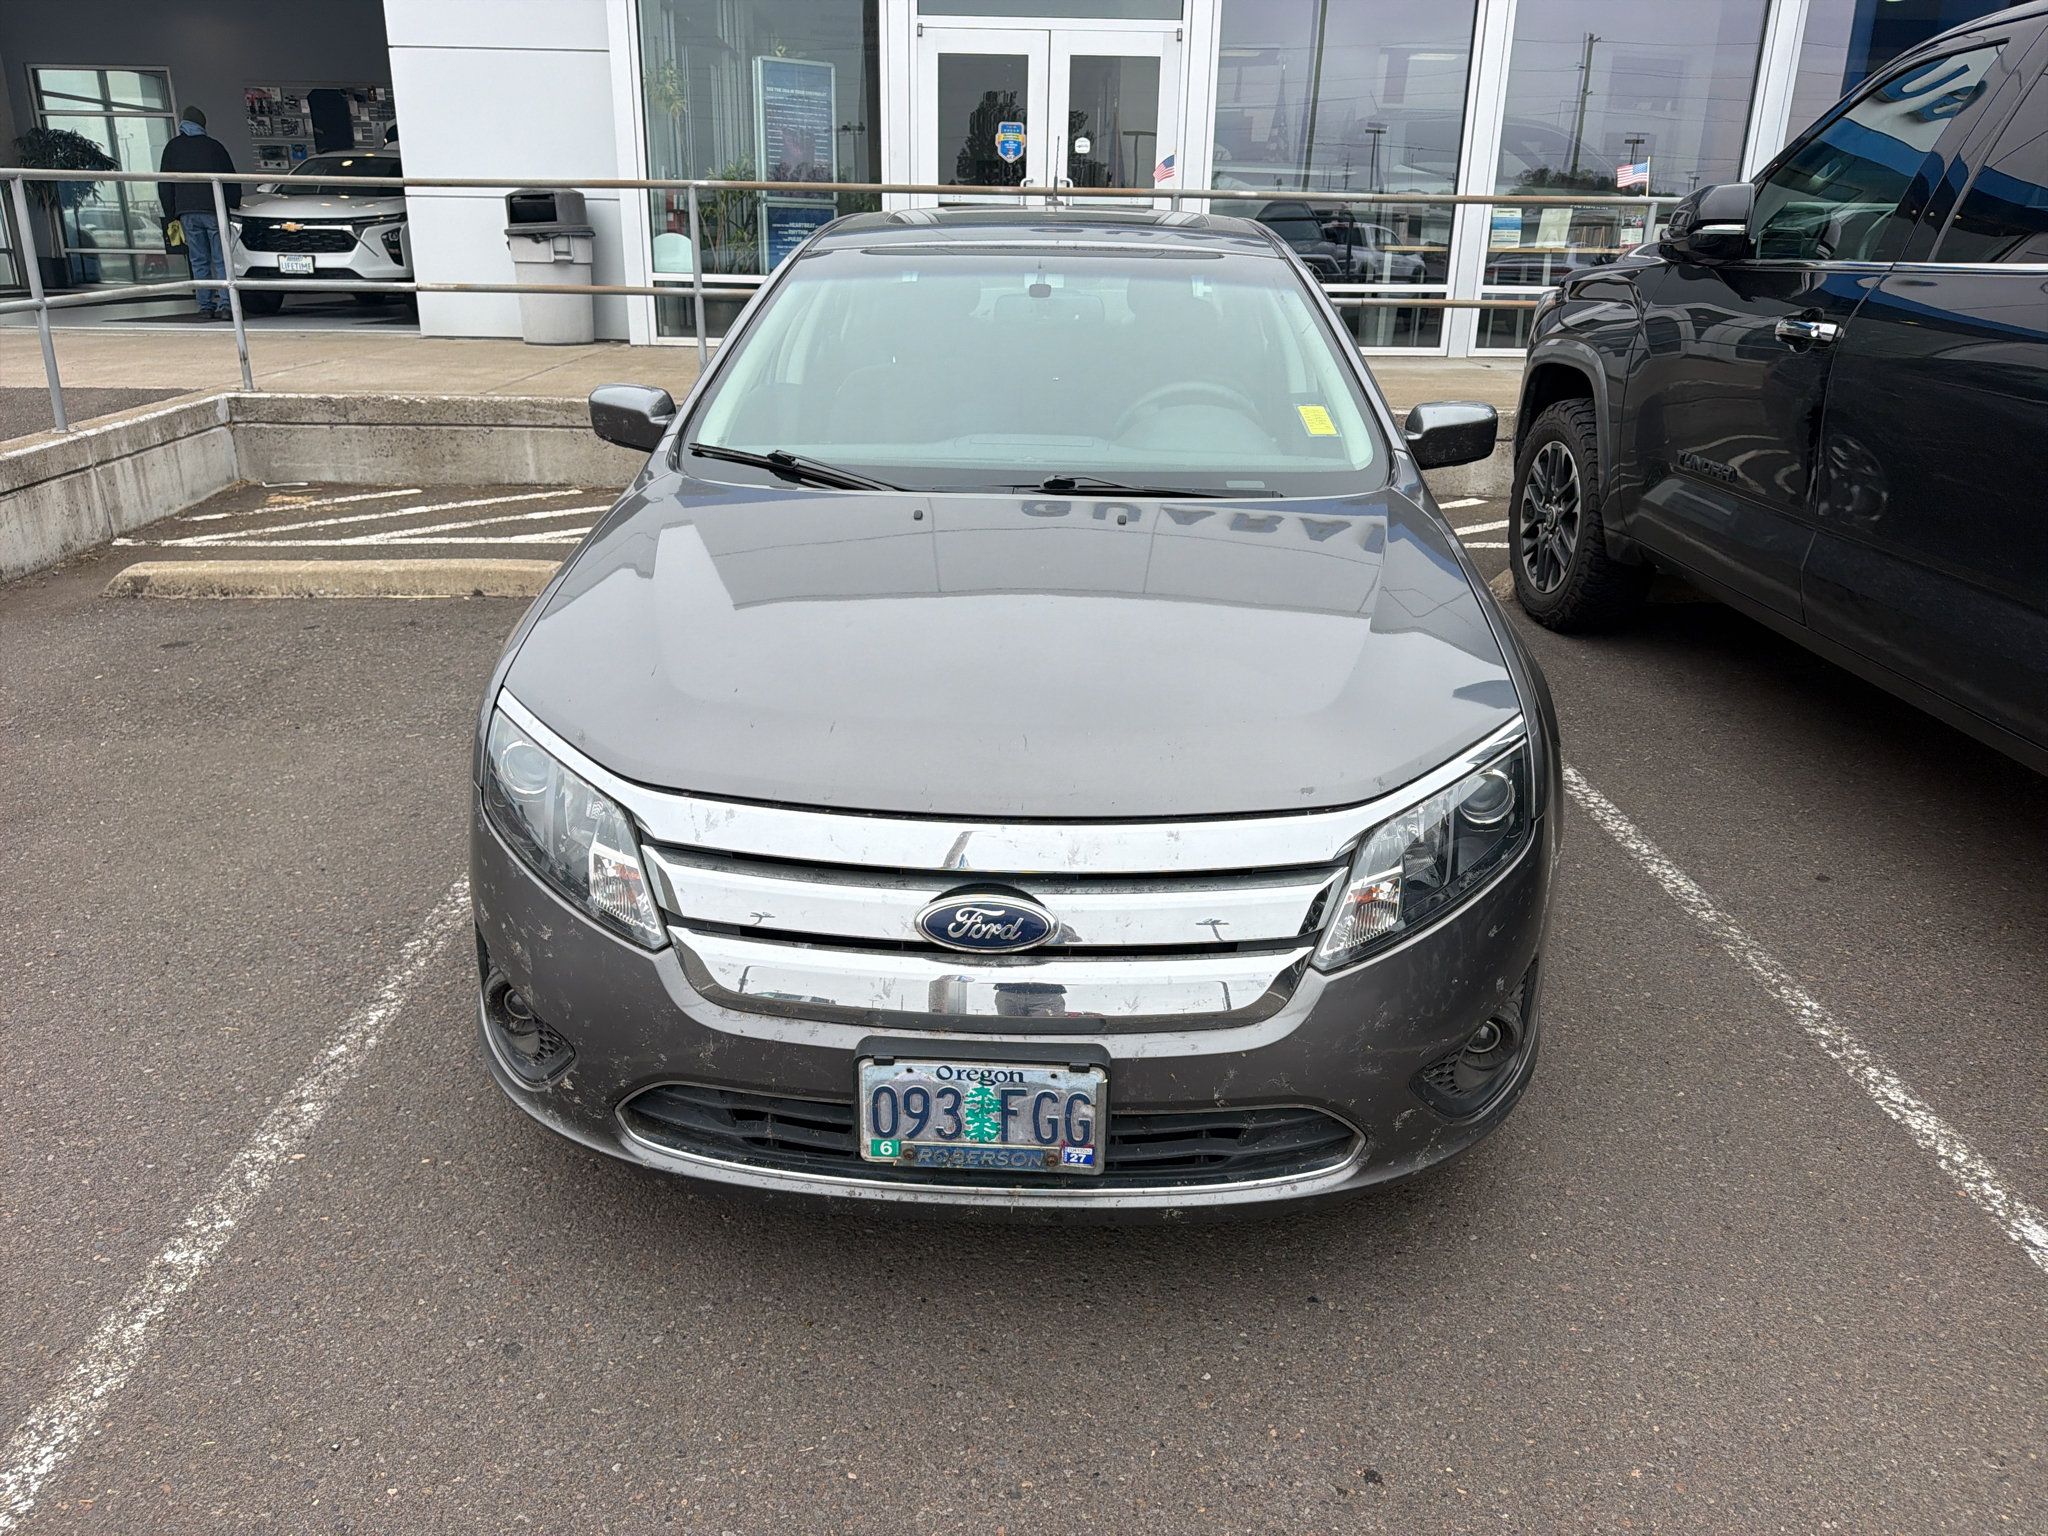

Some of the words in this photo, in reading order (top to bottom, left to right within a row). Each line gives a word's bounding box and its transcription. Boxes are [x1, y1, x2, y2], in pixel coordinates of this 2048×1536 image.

[281, 262, 312, 271] LIFETIME
[1676, 449, 1738, 483] TUNDRA
[947, 906, 1024, 940] Ford
[935, 1065, 1025, 1087] Oregon
[871, 1085, 963, 1141] 093
[1000, 1088, 1092, 1147] FGG
[880, 1140, 893, 1156] 6
[1069, 1153, 1087, 1163] 27
[916, 1149, 1045, 1168] ROBERSON
